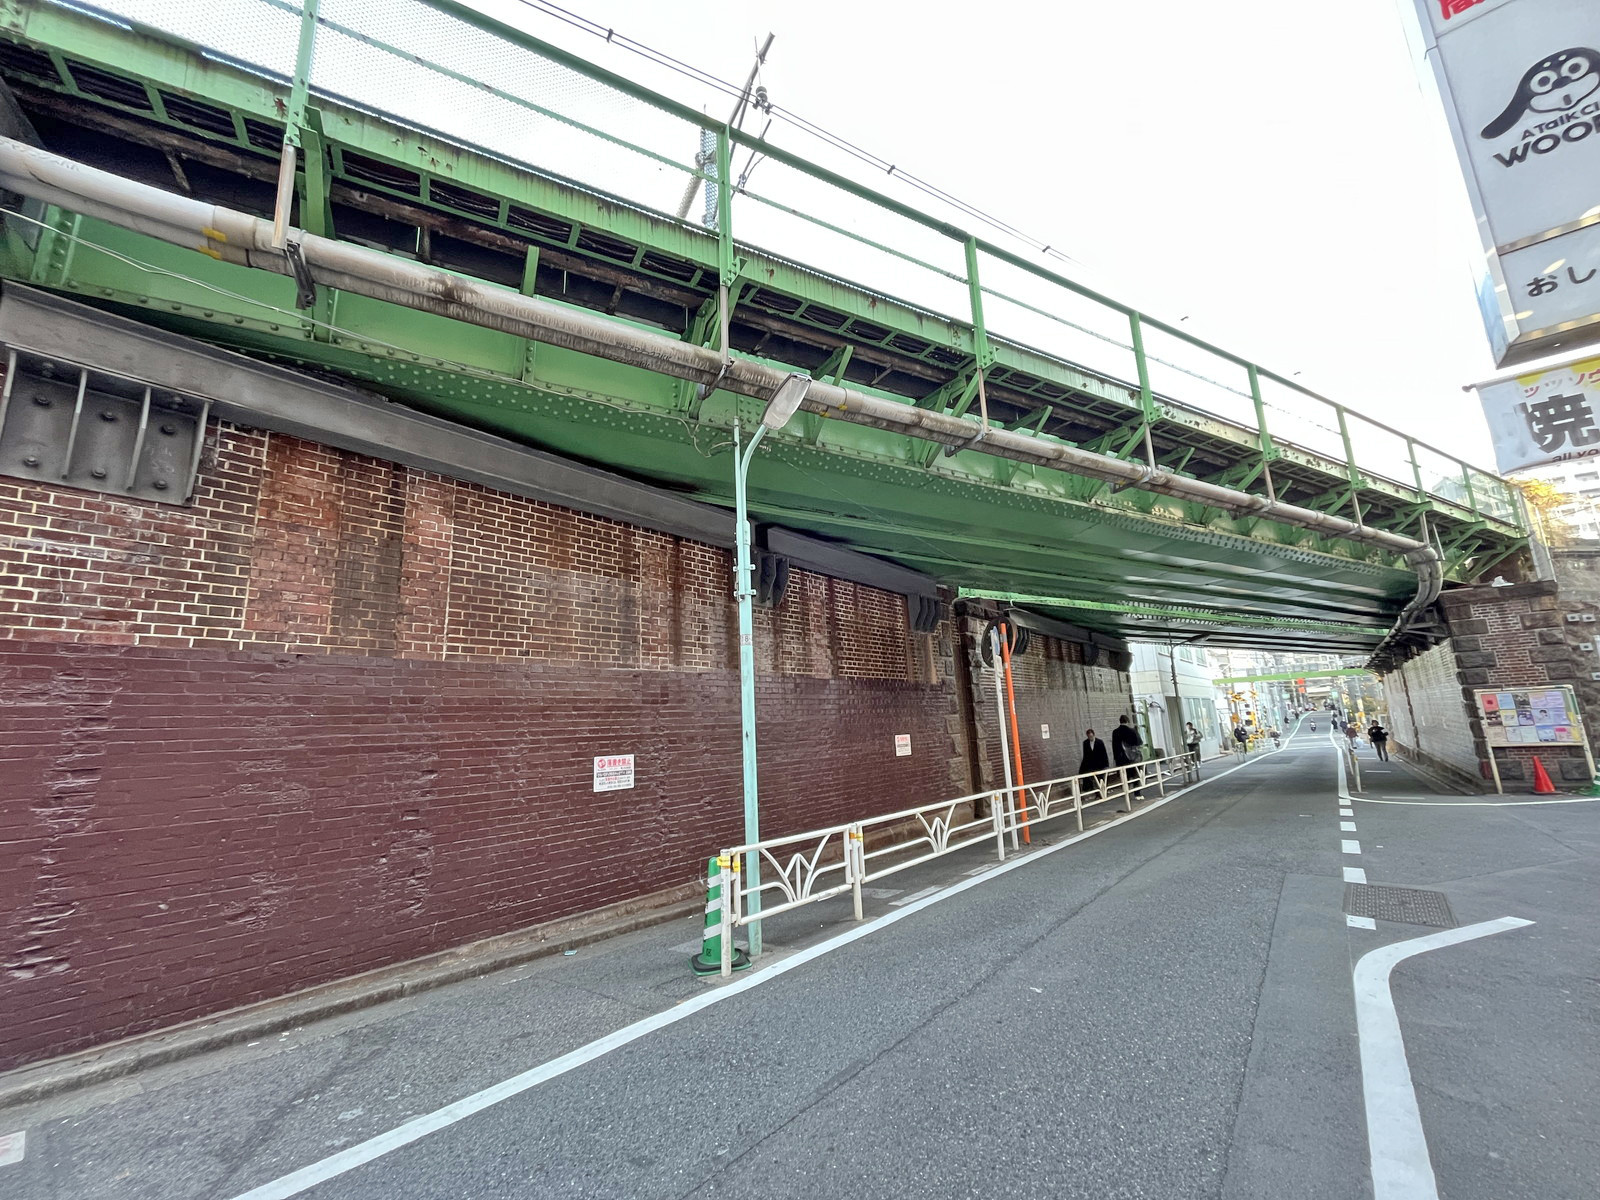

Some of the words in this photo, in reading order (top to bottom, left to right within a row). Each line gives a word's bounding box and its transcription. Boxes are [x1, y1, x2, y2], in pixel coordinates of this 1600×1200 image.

[1521, 129, 1535, 141] A
[1534, 111, 1580, 134] Talk
[1526, 266, 1597, 297] おし
